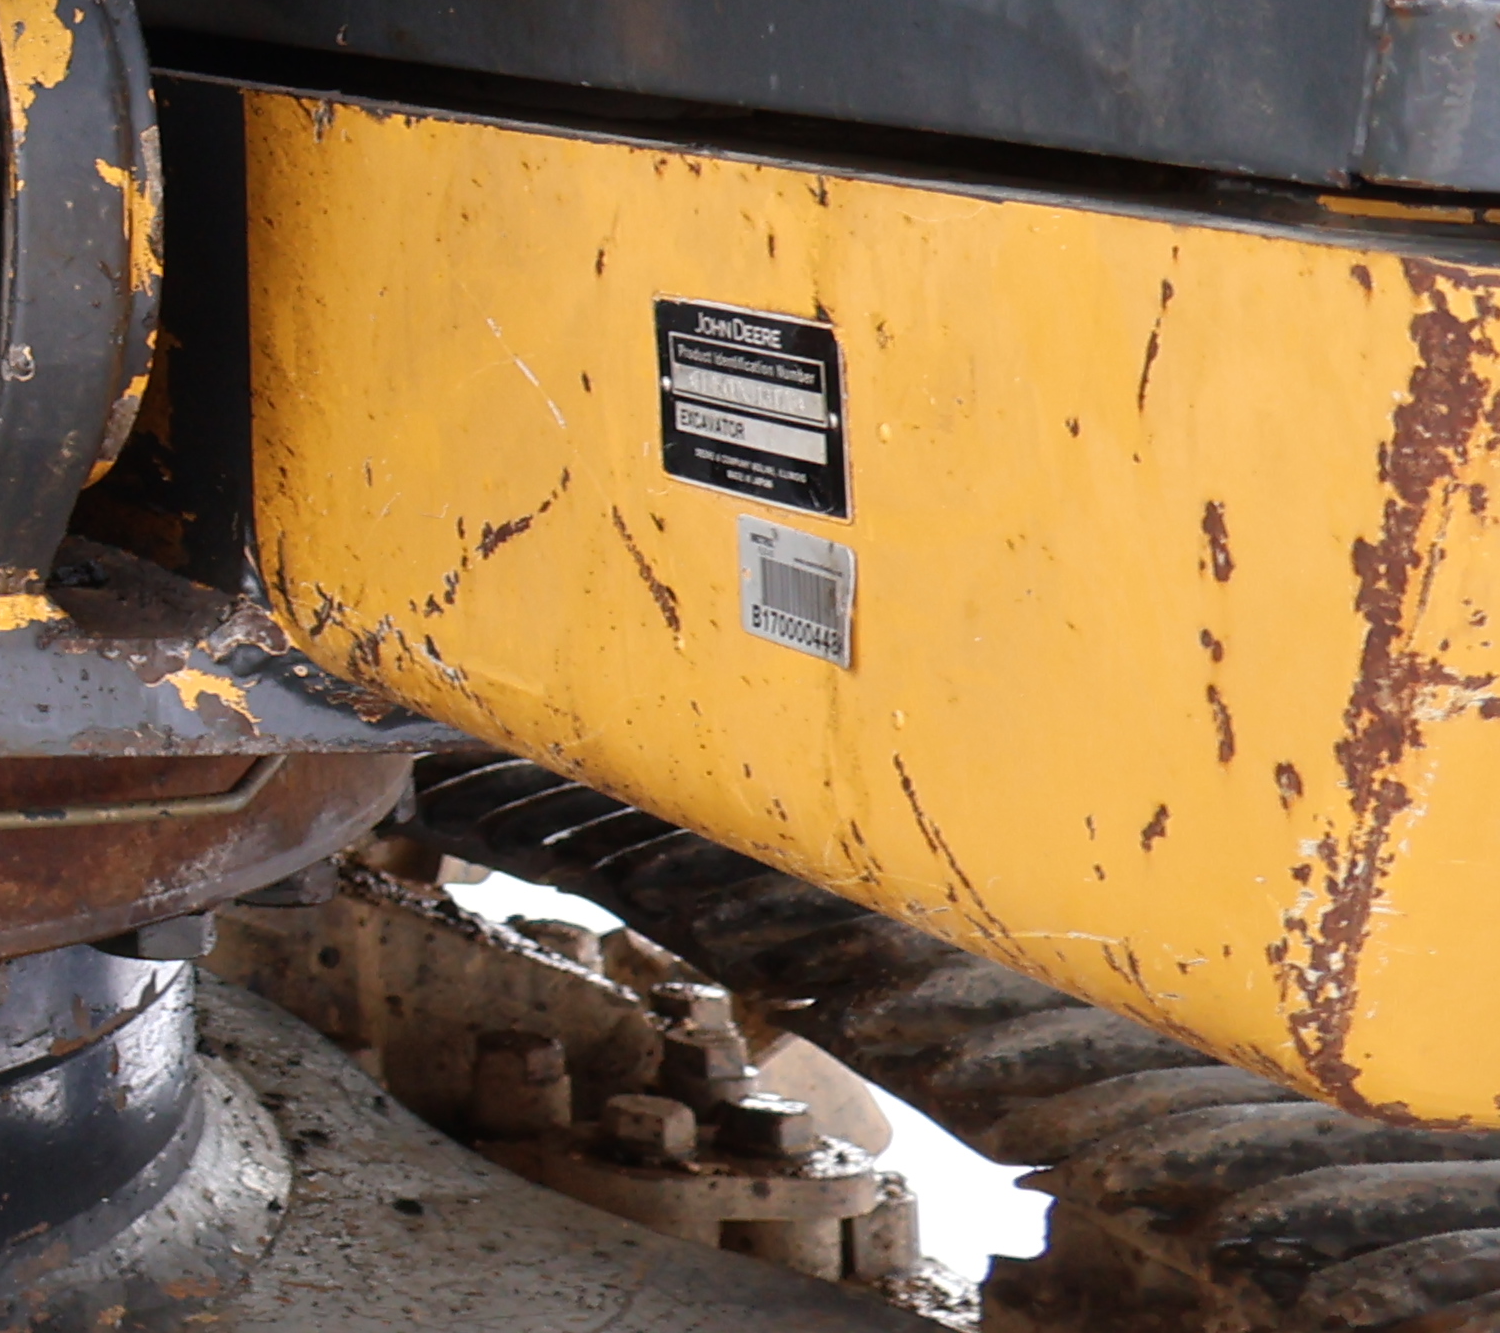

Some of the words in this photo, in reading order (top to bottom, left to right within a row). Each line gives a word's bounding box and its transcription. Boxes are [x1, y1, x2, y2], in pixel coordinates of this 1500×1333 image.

[694, 312, 732, 340] JOHN
[733, 318, 782, 349] DEERE
[677, 343, 712, 364] Product
[713, 352, 775, 377] Identification
[775, 364, 816, 385] Number
[680, 408, 746, 440] EXCAVATOR
